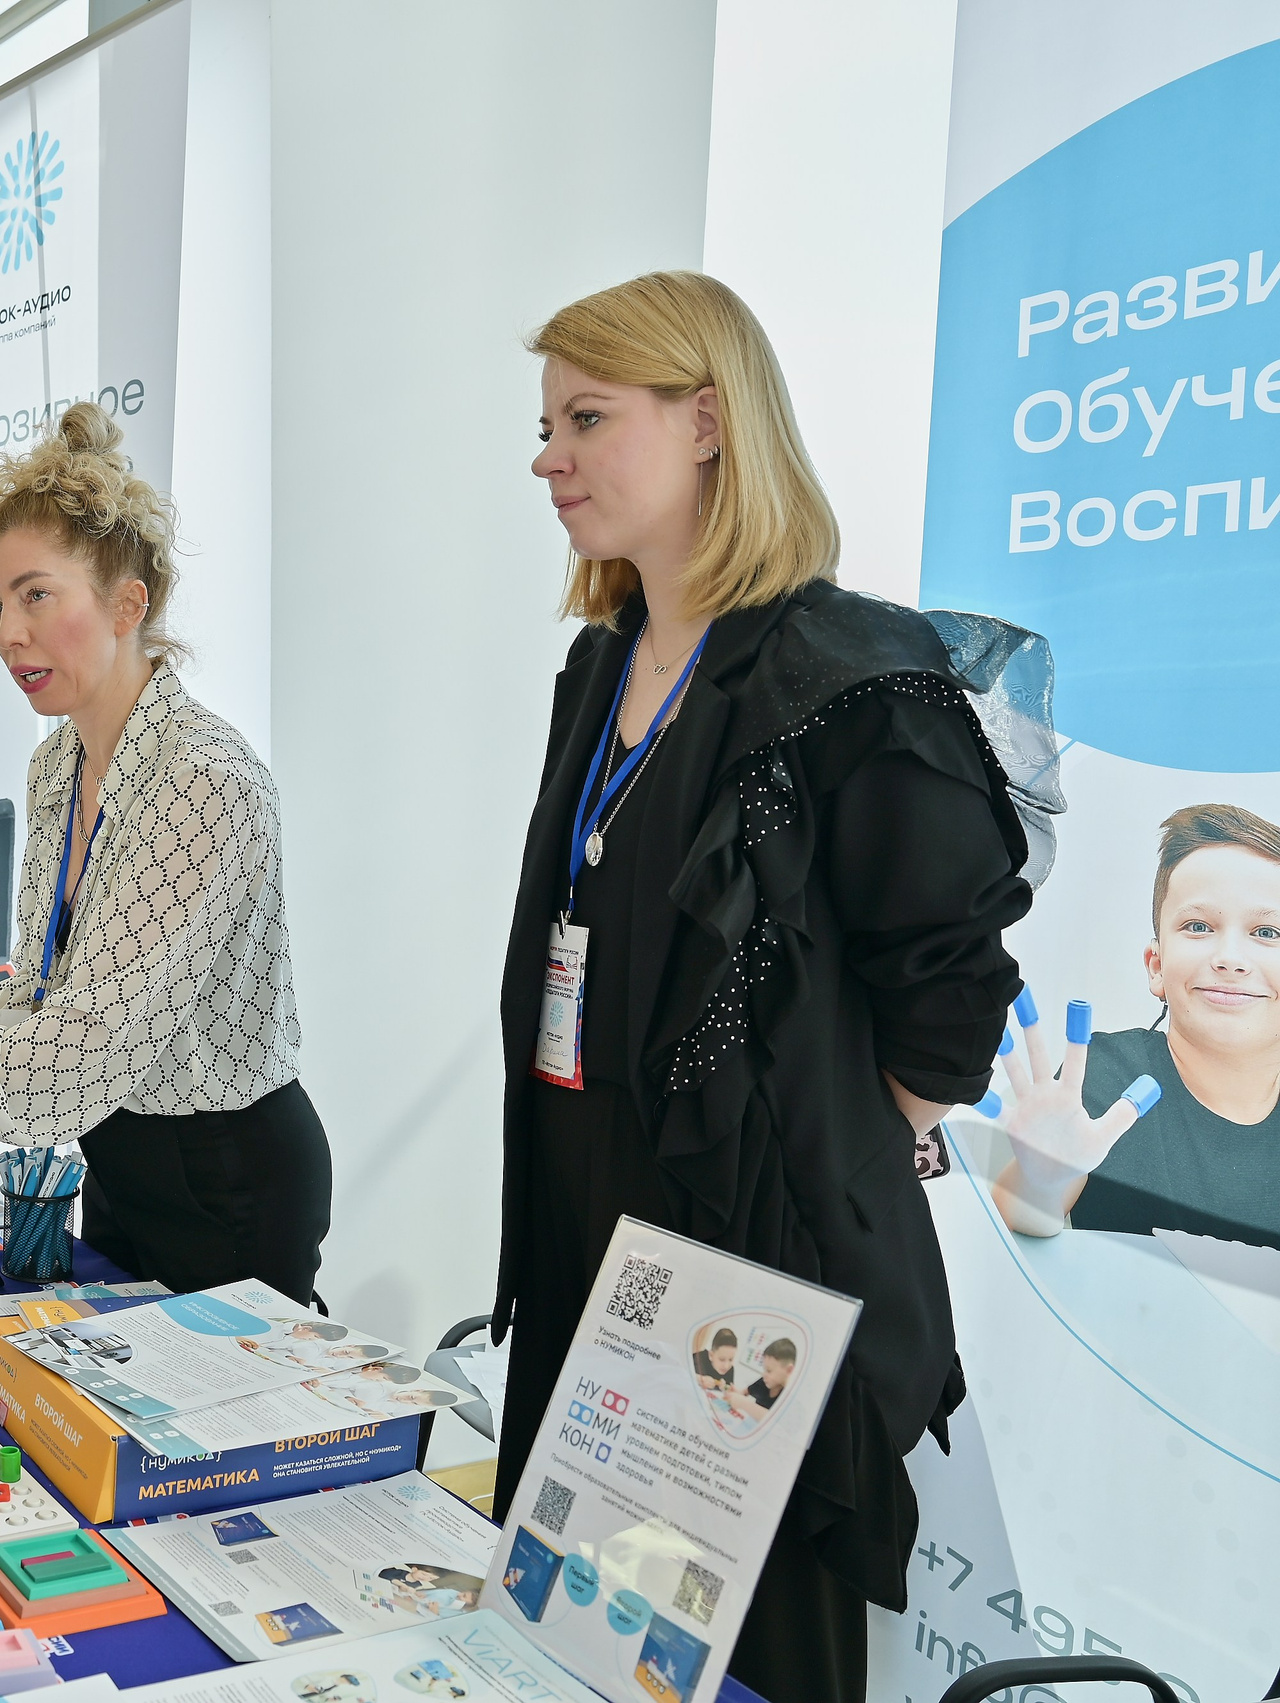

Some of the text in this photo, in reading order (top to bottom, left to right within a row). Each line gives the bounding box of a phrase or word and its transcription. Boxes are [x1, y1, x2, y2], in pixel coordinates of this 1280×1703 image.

[14, 314, 56, 340] компаний
[546, 972, 575, 986] ЭКСПОНЕНТ
[598, 1325, 662, 1361] Узнать подробнее
[599, 1339, 636, 1362] НУМИКОН
[575, 1376, 602, 1400] НУ
[34, 1393, 83, 1448] ВТОРОЙ ШАГ
[344, 1423, 381, 1442] ШАГ
[592, 1412, 622, 1440] МИ
[636, 1407, 731, 1461] система для обучения
[558, 1422, 595, 1455] КОН
[272, 1456, 371, 1479] ОНА СТАНОВИТСЯ УВЛЕКАТЕЛЬНОЙ
[273, 1462, 295, 1472] МОЖЕТ
[295, 1458, 324, 1468] КАЗАТЬСЯ
[324, 1452, 355, 1463] СЛОЖНОЙ,
[354, 1450, 364, 1458] НО
[368, 1444, 402, 1456] «НУМИКОД»
[625, 1434, 743, 1501] уровнем подготовки, типом
[631, 1421, 749, 1487] математике детей с разным
[138, 1468, 260, 1500] МАТЕМАТИКА
[616, 1461, 655, 1488] здоровья
[621, 1448, 743, 1519] мышления и возможностями
[550, 1452, 583, 1476] Приобрести
[583, 1473, 634, 1505] образовательные
[668, 1521, 681, 1532] для
[681, 1529, 738, 1564] индивидуальных
[601, 1495, 625, 1511] занятий
[626, 1509, 646, 1523] можно
[568, 1565, 596, 1588] Первый
[917, 1541, 974, 1592] +7
[570, 1582, 585, 1594] шаг
[617, 1613, 632, 1626] шаг
